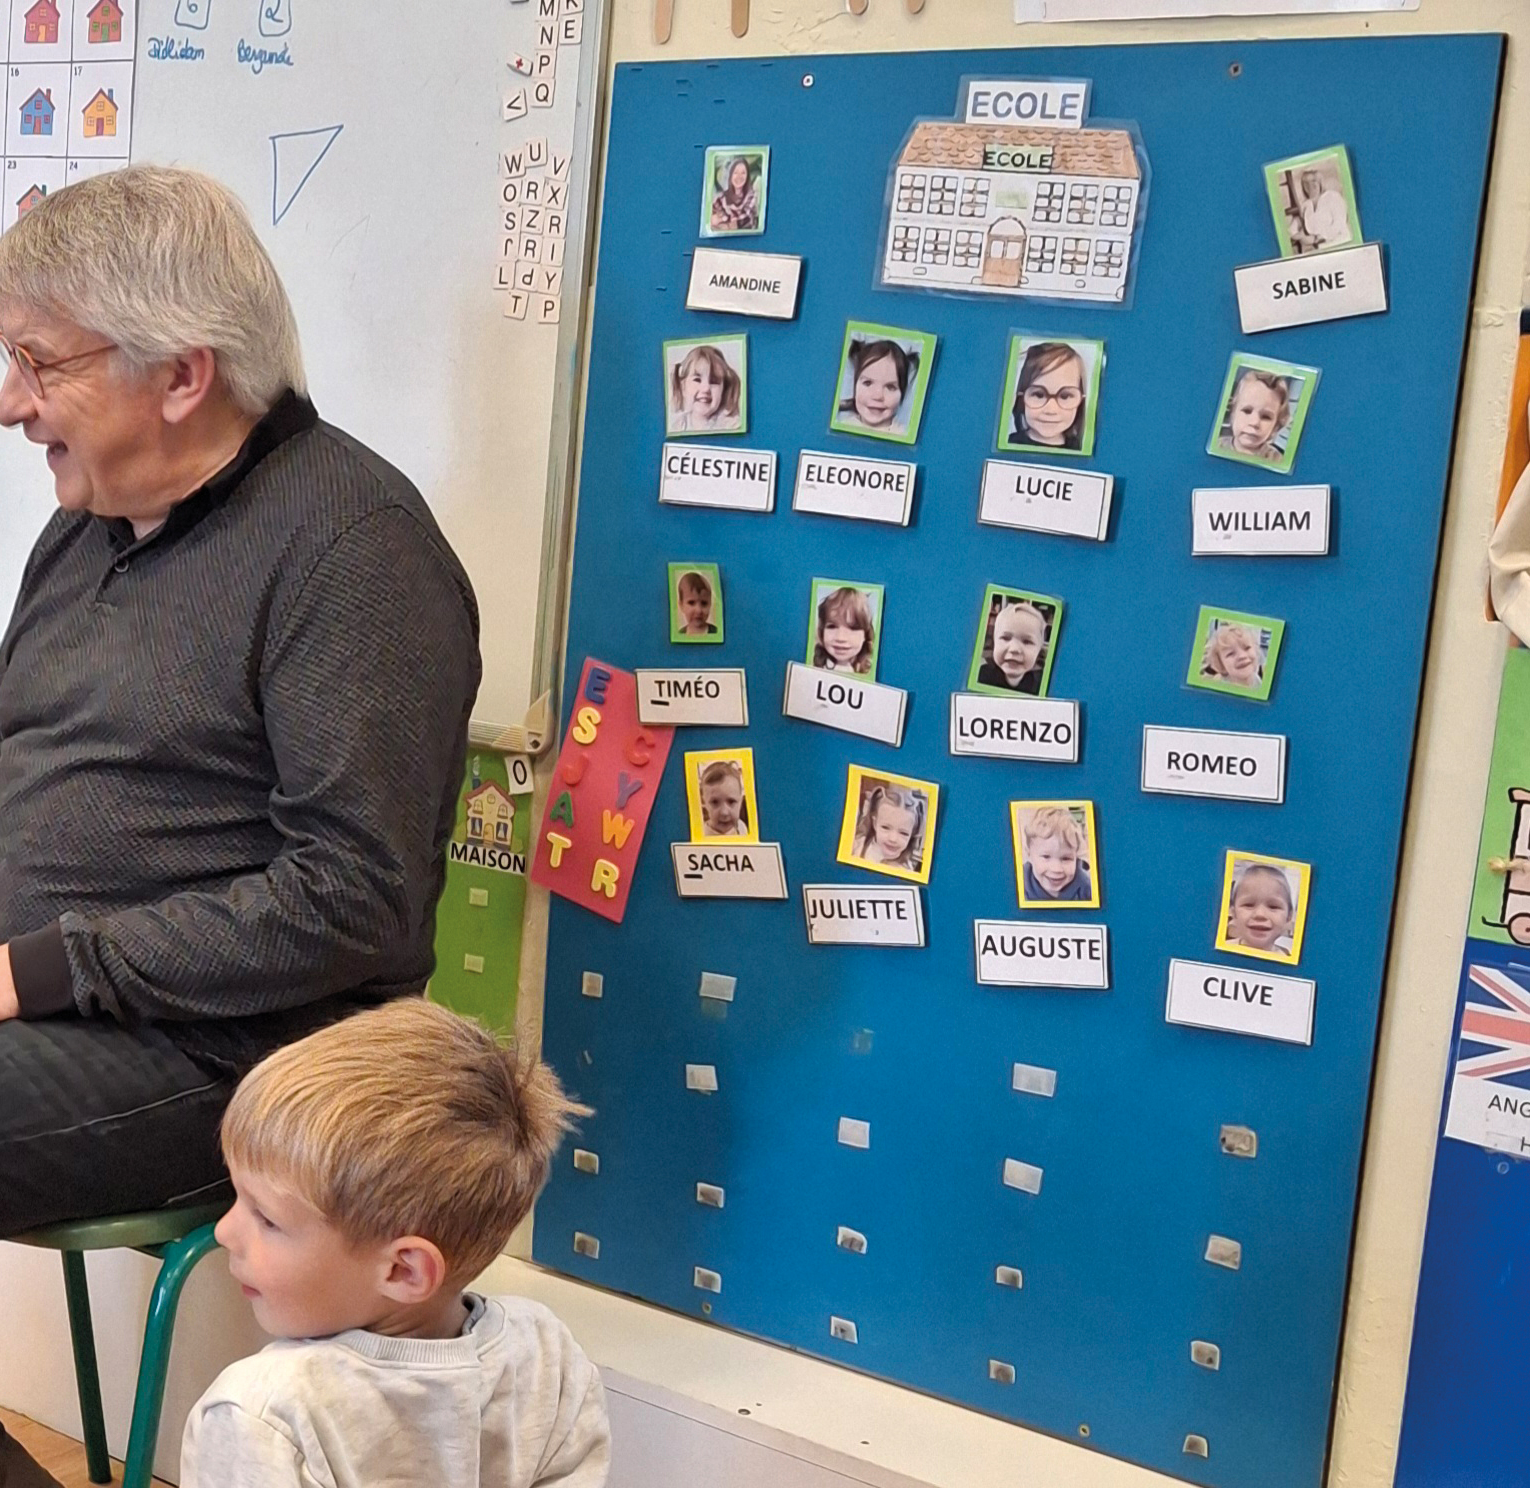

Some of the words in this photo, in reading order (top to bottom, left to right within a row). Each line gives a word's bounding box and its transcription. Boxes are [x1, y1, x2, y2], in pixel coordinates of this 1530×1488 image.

[540, 26, 553, 45] N
[564, 19, 575, 39] E
[539, 55, 550, 73] P
[535, 83, 550, 103] Q
[970, 90, 1081, 121] ECOLE
[504, 153, 522, 174] W
[553, 156, 565, 175] V
[982, 150, 1053, 169] ECOLE
[526, 181, 539, 200] R
[547, 186, 561, 205] X
[505, 212, 516, 230] S
[526, 210, 539, 228] Z
[549, 215, 561, 234] R
[524, 239, 536, 258] R
[499, 266, 508, 285] L
[545, 271, 556, 289] Y
[708, 272, 782, 295] AMANDINE
[1272, 271, 1346, 300] SABINE
[511, 295, 522, 313] T
[543, 300, 555, 318] P
[667, 451, 769, 483] CÉLESTINE
[804, 463, 906, 493] ELEONORE
[1015, 475, 1073, 502] LUCIE
[1208, 510, 1312, 533] WILLIAM
[584, 667, 611, 704] E
[654, 675, 721, 699] TIMÉO
[815, 682, 865, 710] LOU
[572, 707, 601, 744] S
[958, 715, 1073, 746] LORENZO
[1166, 750, 1259, 779] ROMEO
[615, 771, 643, 809] Y
[549, 791, 575, 828] A
[602, 809, 635, 849] W
[449, 842, 527, 873] MAISON
[546, 831, 573, 868] T
[687, 852, 755, 874] SACHA
[590, 858, 620, 898] R
[809, 898, 908, 923] JULIETTE
[981, 935, 1102, 962] AUGUSTE
[1201, 975, 1274, 1007] CLIVE
